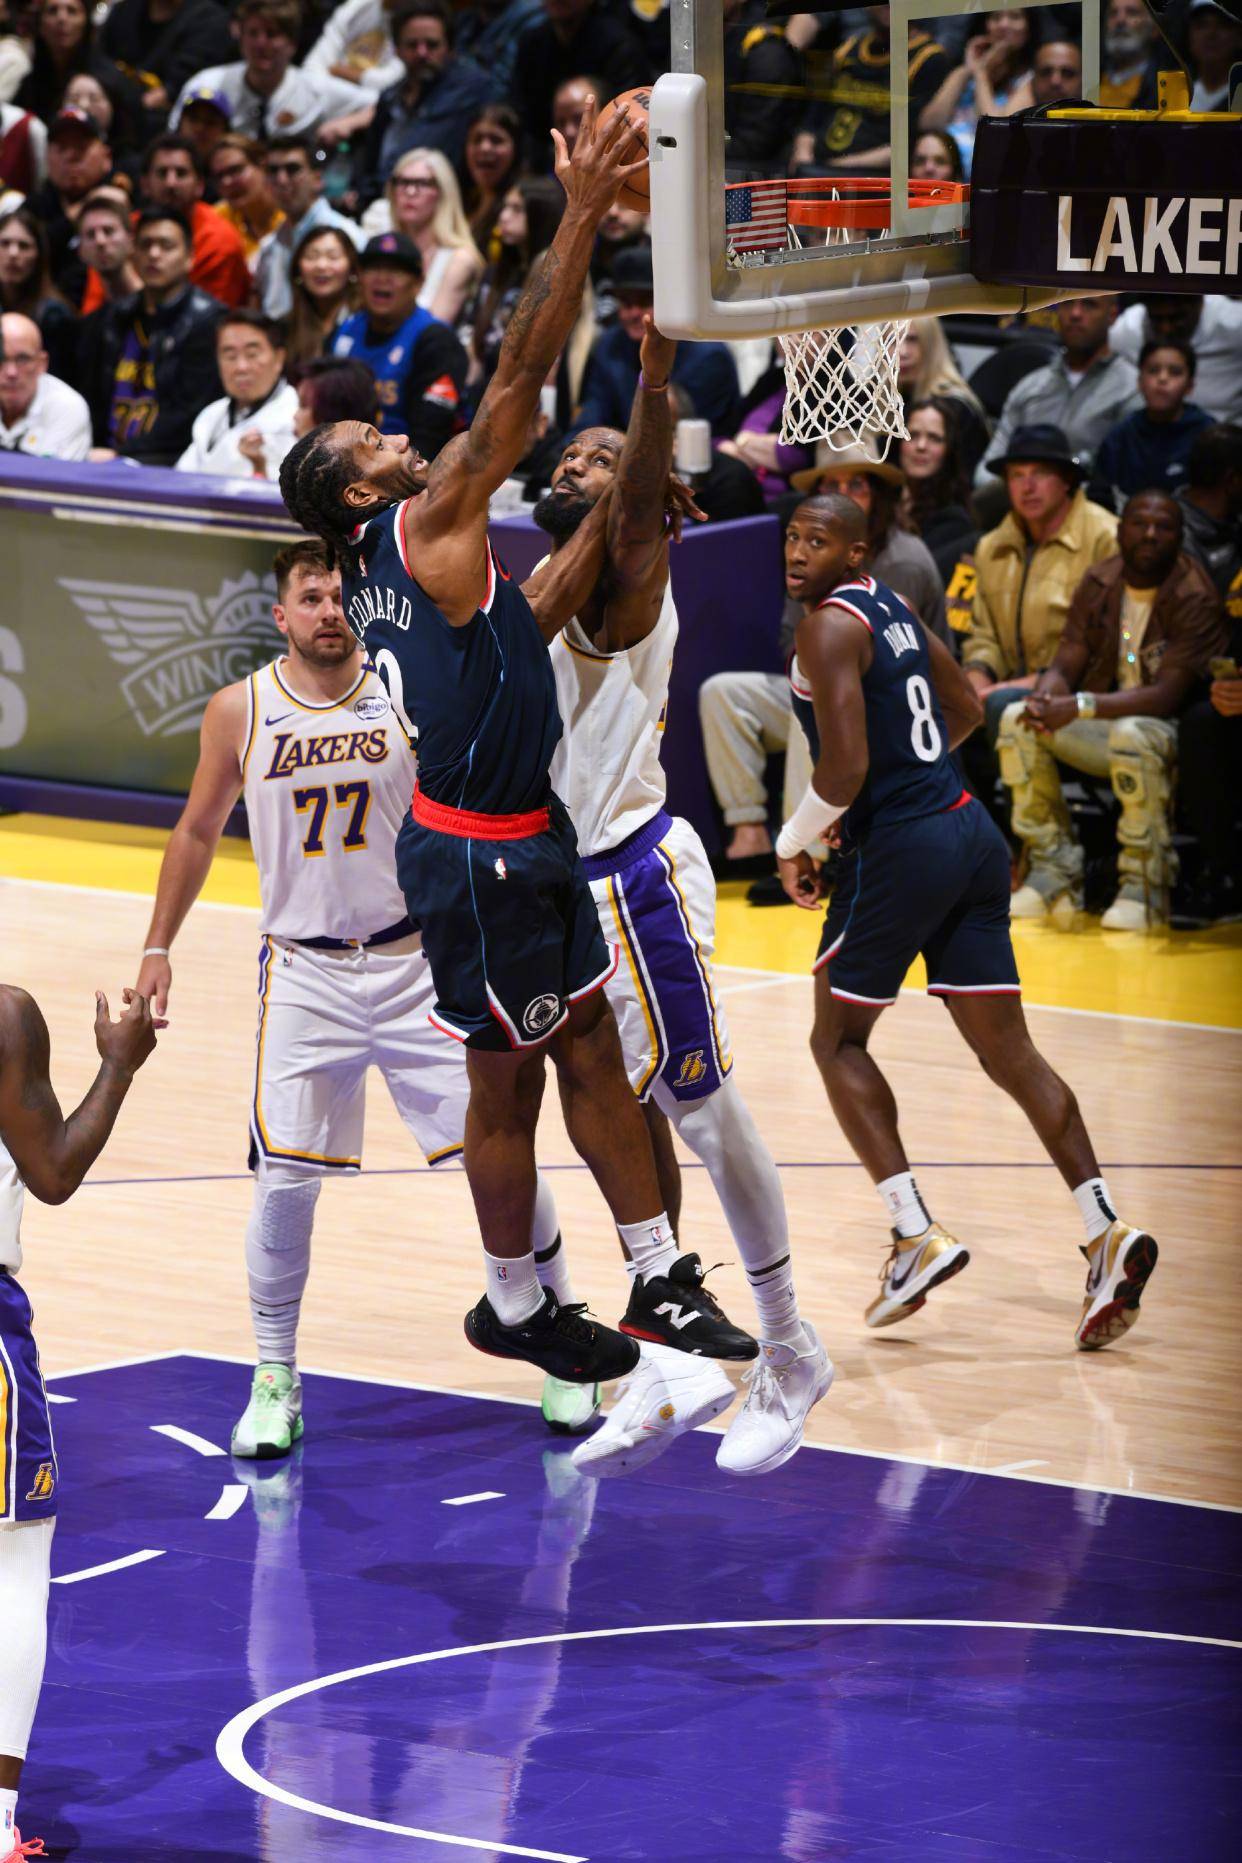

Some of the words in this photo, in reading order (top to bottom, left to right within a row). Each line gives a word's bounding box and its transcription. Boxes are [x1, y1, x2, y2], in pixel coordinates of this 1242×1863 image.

[263, 728, 390, 782] LAKERS
[906, 674, 942, 763] 8
[292, 780, 373, 859] 77
